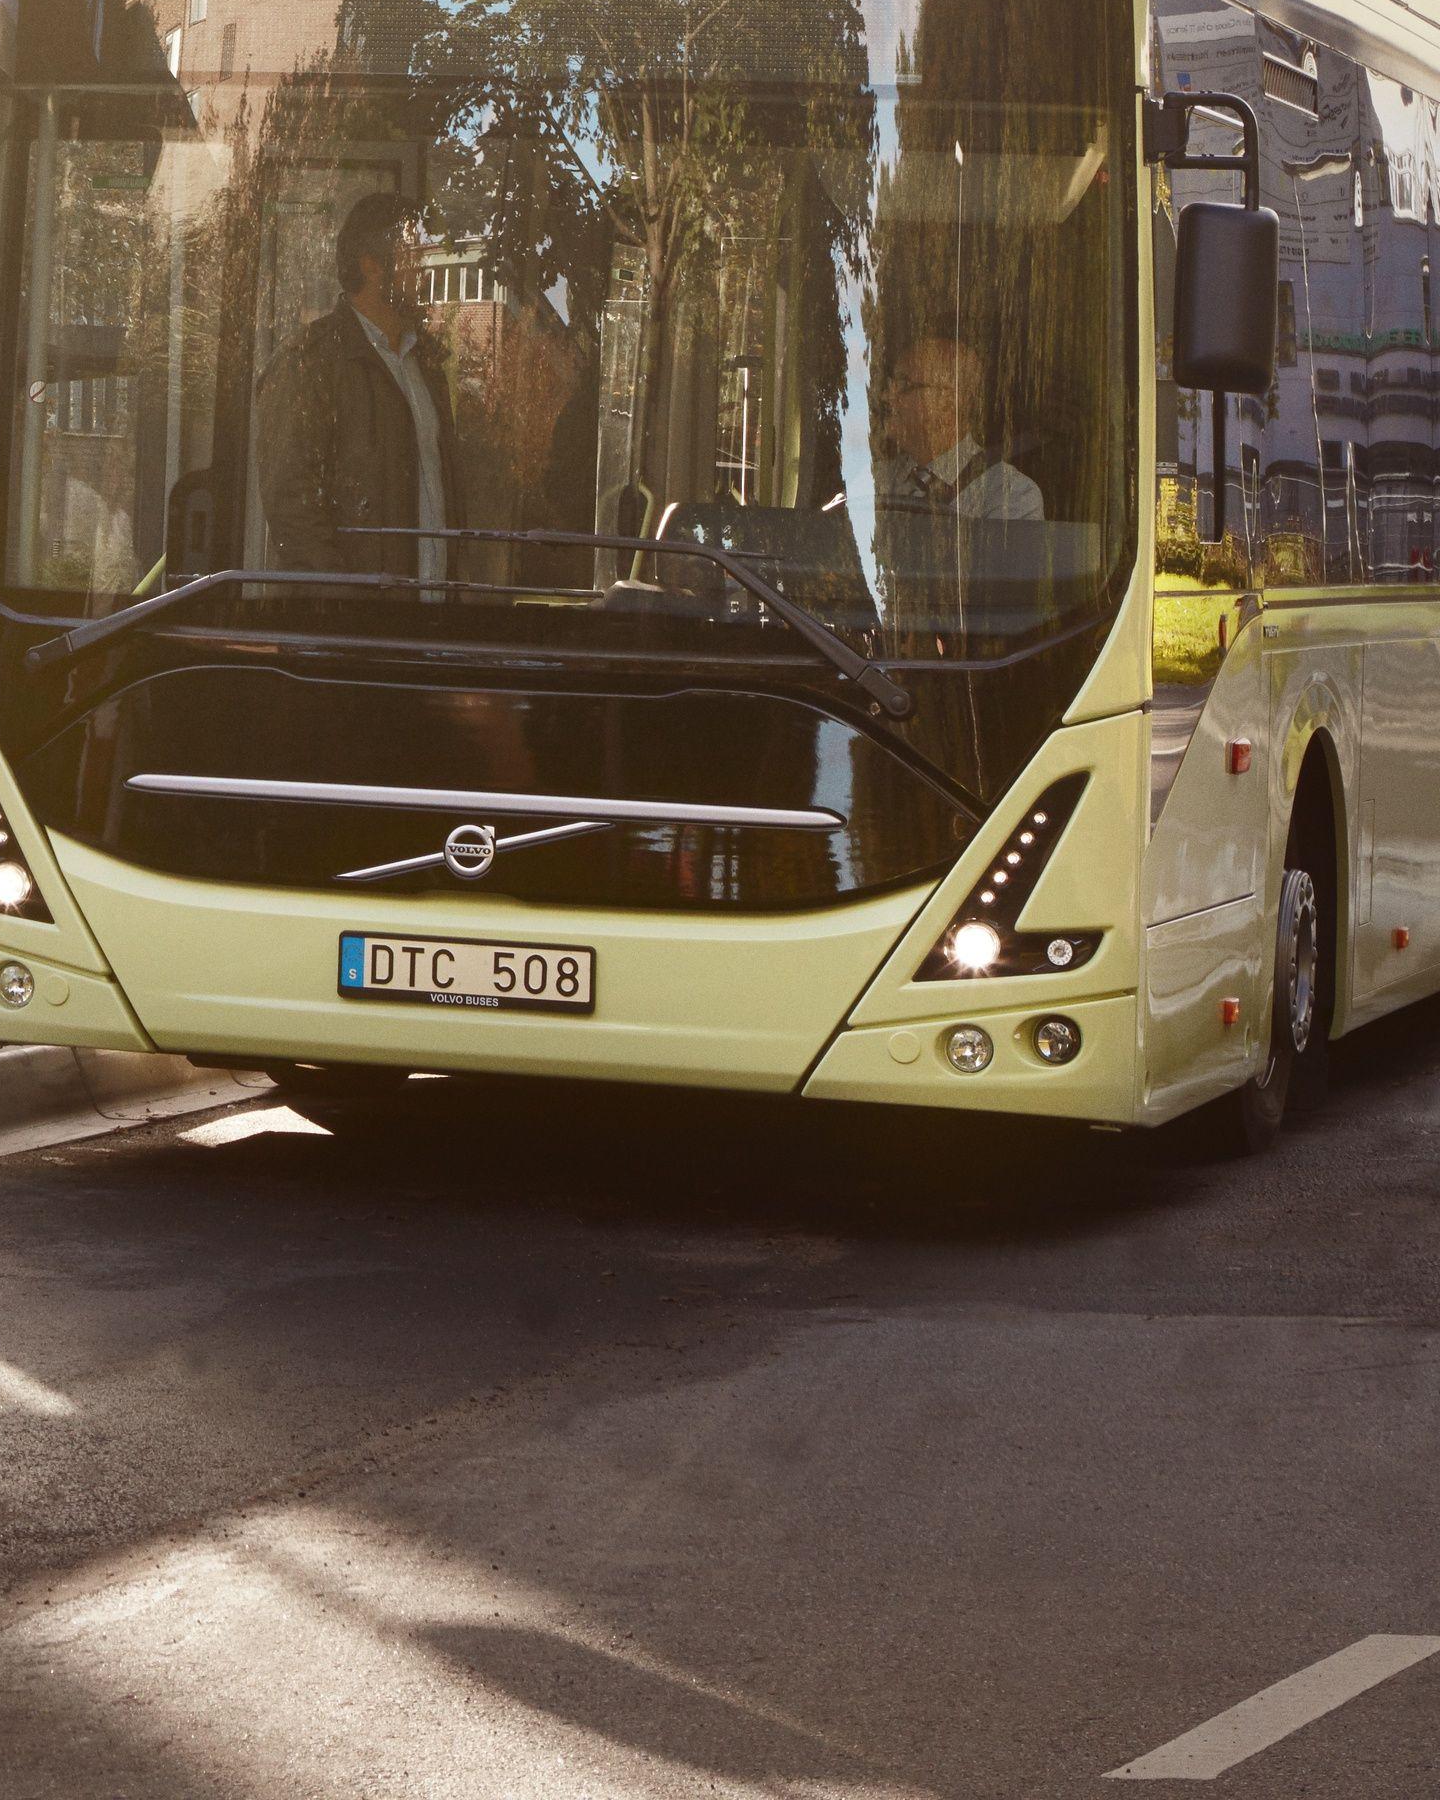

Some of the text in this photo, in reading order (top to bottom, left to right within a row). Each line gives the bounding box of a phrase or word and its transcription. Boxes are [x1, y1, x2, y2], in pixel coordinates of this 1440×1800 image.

[447, 845, 491, 856] VOLVO
[348, 944, 579, 997] S DTC 508
[430, 993, 499, 1007] VOLVO BUSES
